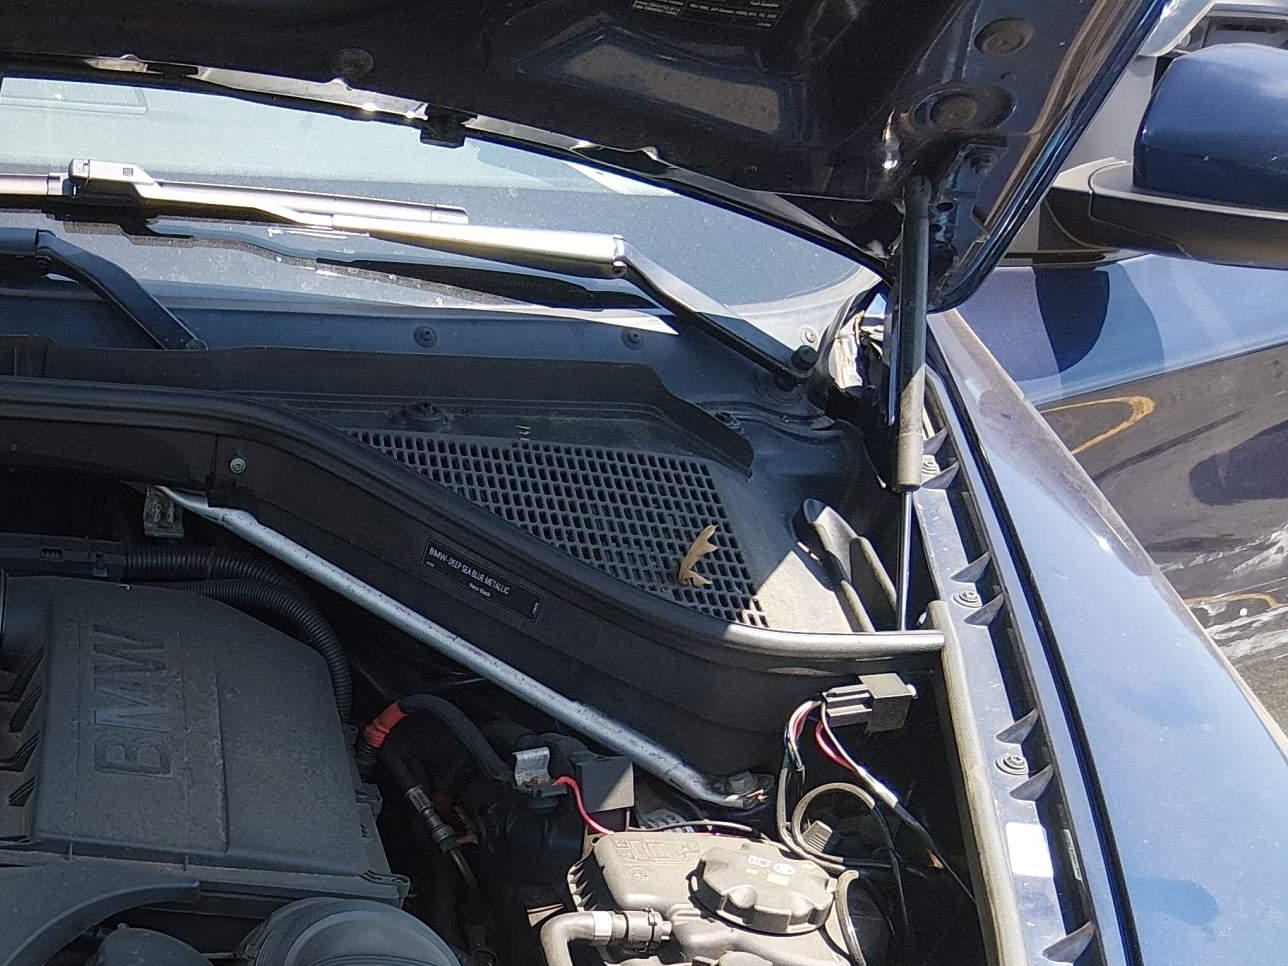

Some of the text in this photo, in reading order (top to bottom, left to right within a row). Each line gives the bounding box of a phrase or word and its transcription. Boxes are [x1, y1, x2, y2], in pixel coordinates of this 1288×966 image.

[461, 564, 472, 576] SEA
[471, 569, 486, 581] BLUE
[484, 575, 511, 595] METALLIC
[93, 623, 173, 776] BMW
